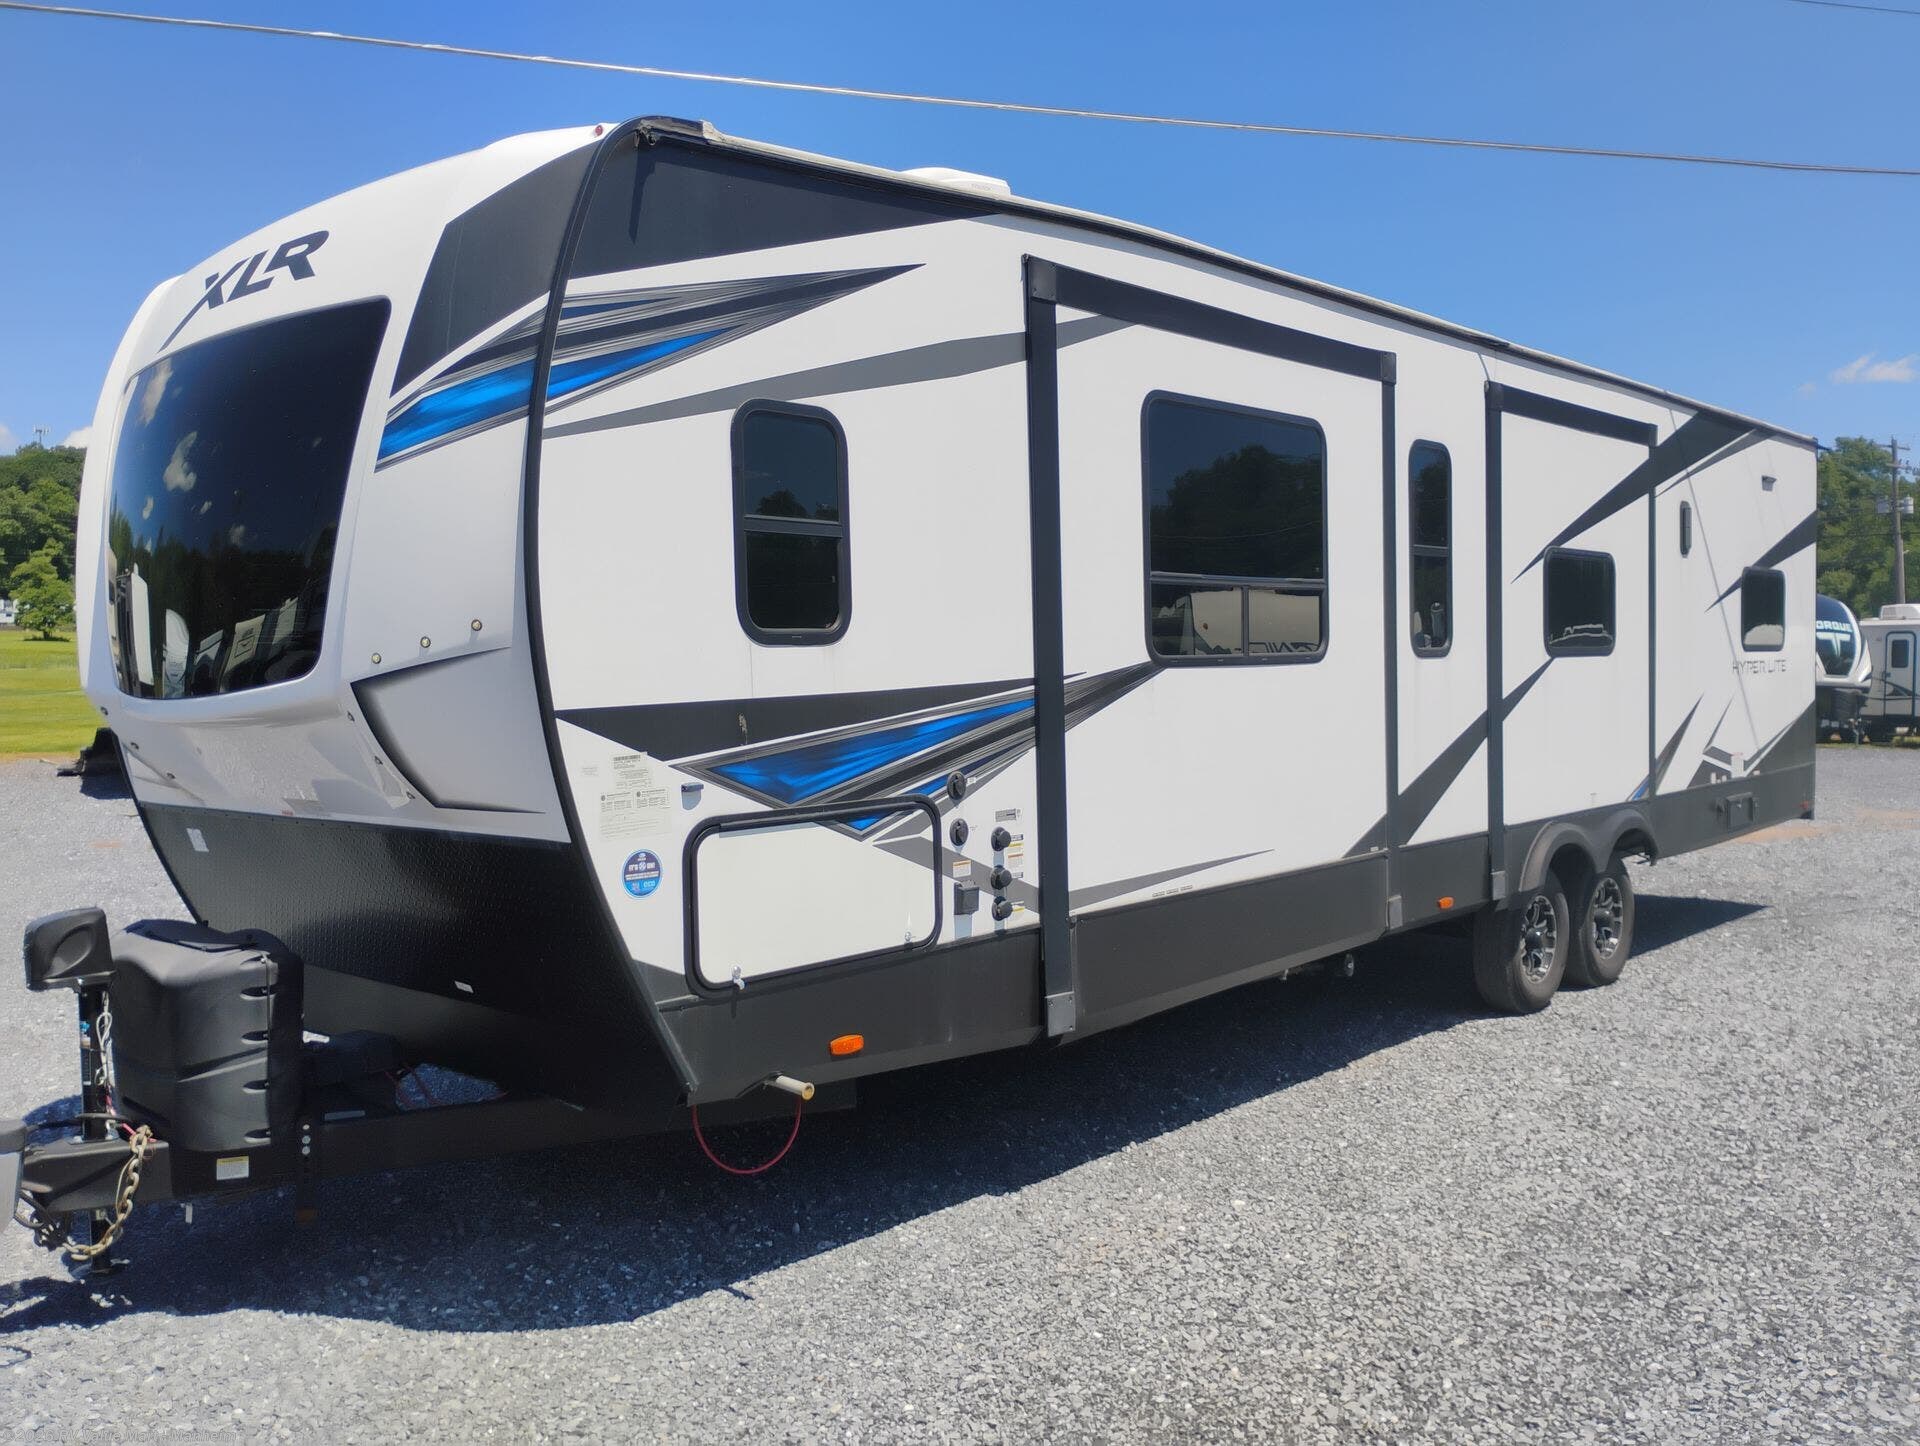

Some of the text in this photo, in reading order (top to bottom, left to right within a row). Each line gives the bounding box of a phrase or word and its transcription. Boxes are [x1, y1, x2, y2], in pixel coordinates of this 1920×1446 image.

[1816, 620, 1853, 632] ORQUE
[1732, 659, 1786, 674] HYPER LITE
